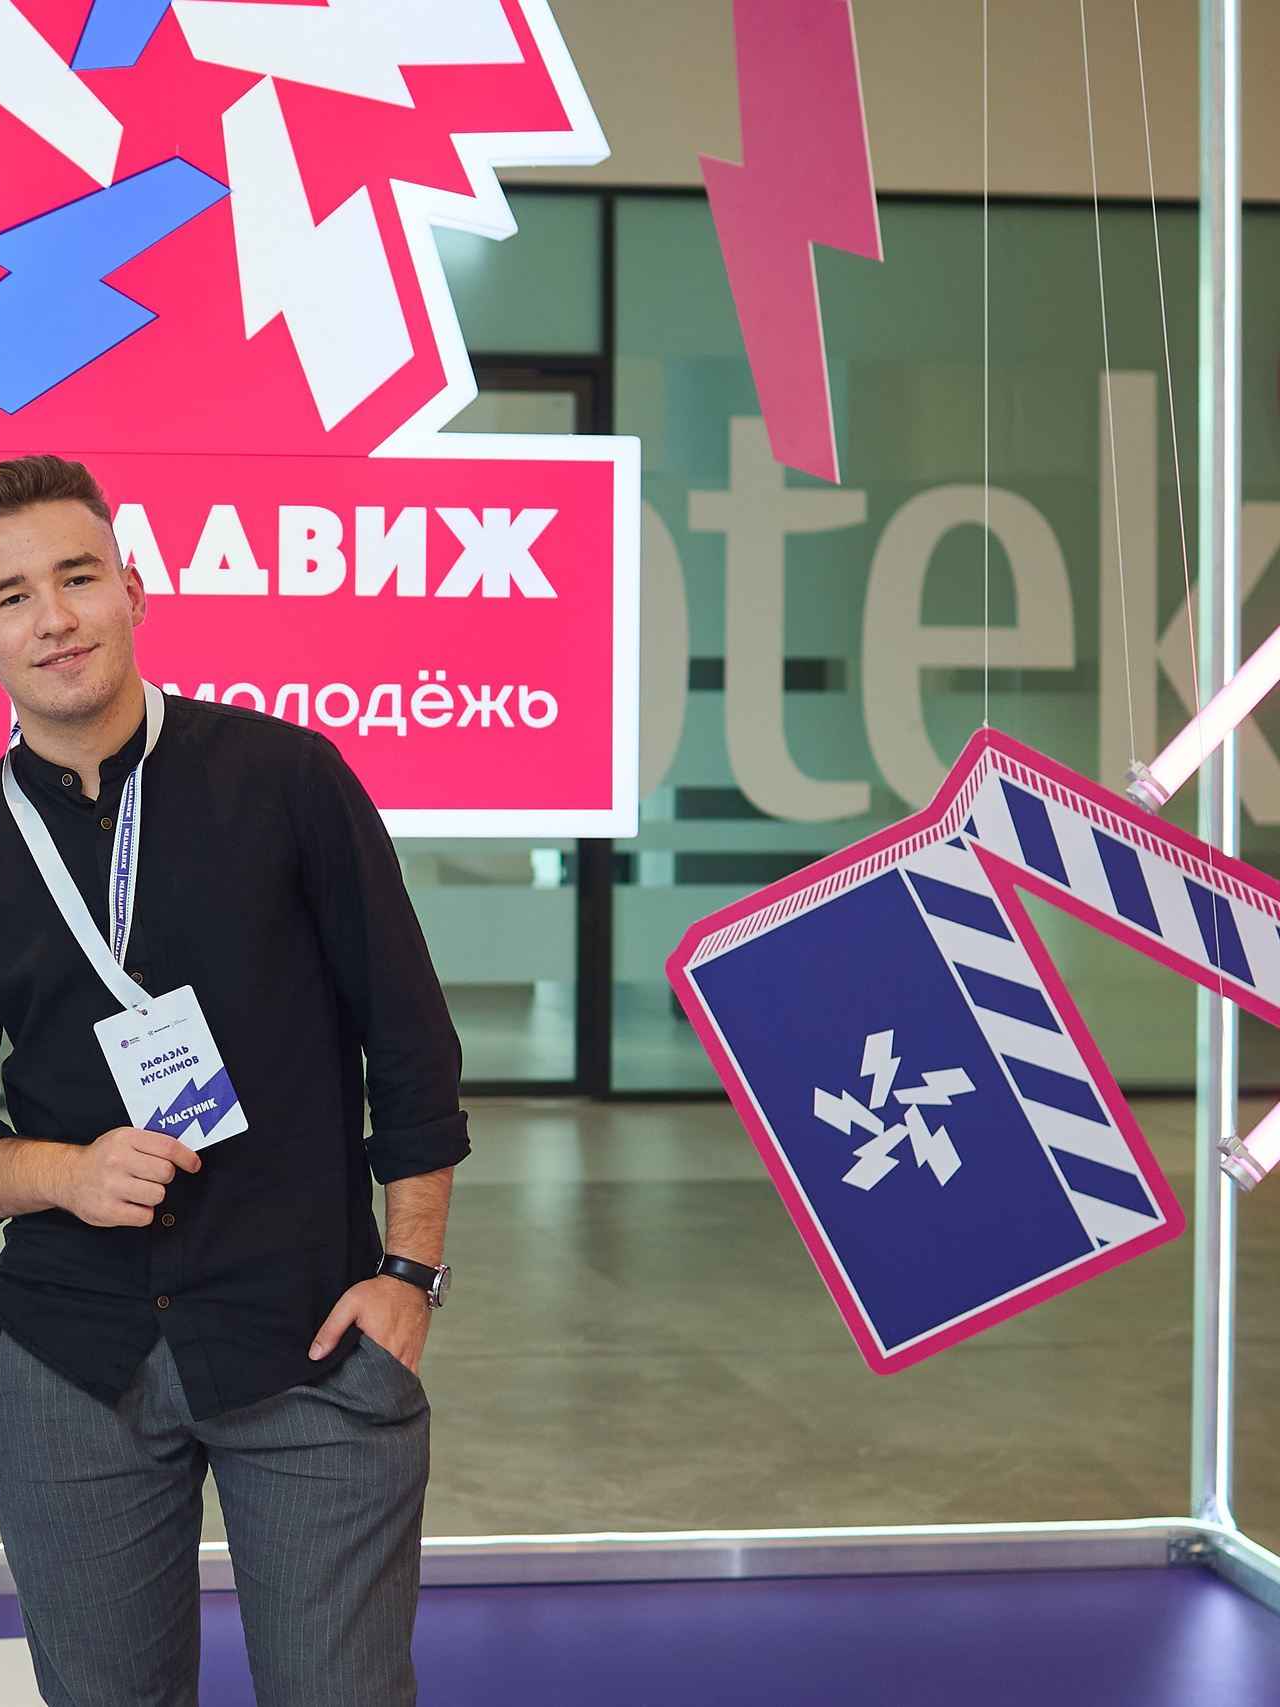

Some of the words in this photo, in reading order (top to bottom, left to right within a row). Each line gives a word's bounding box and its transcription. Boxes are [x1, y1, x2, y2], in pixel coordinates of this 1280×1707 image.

[140, 1045, 189, 1071] РАФАЭЛЬ
[140, 1055, 200, 1086] МУСЛИМОВ
[158, 1097, 218, 1129] УЧАСТНИК
